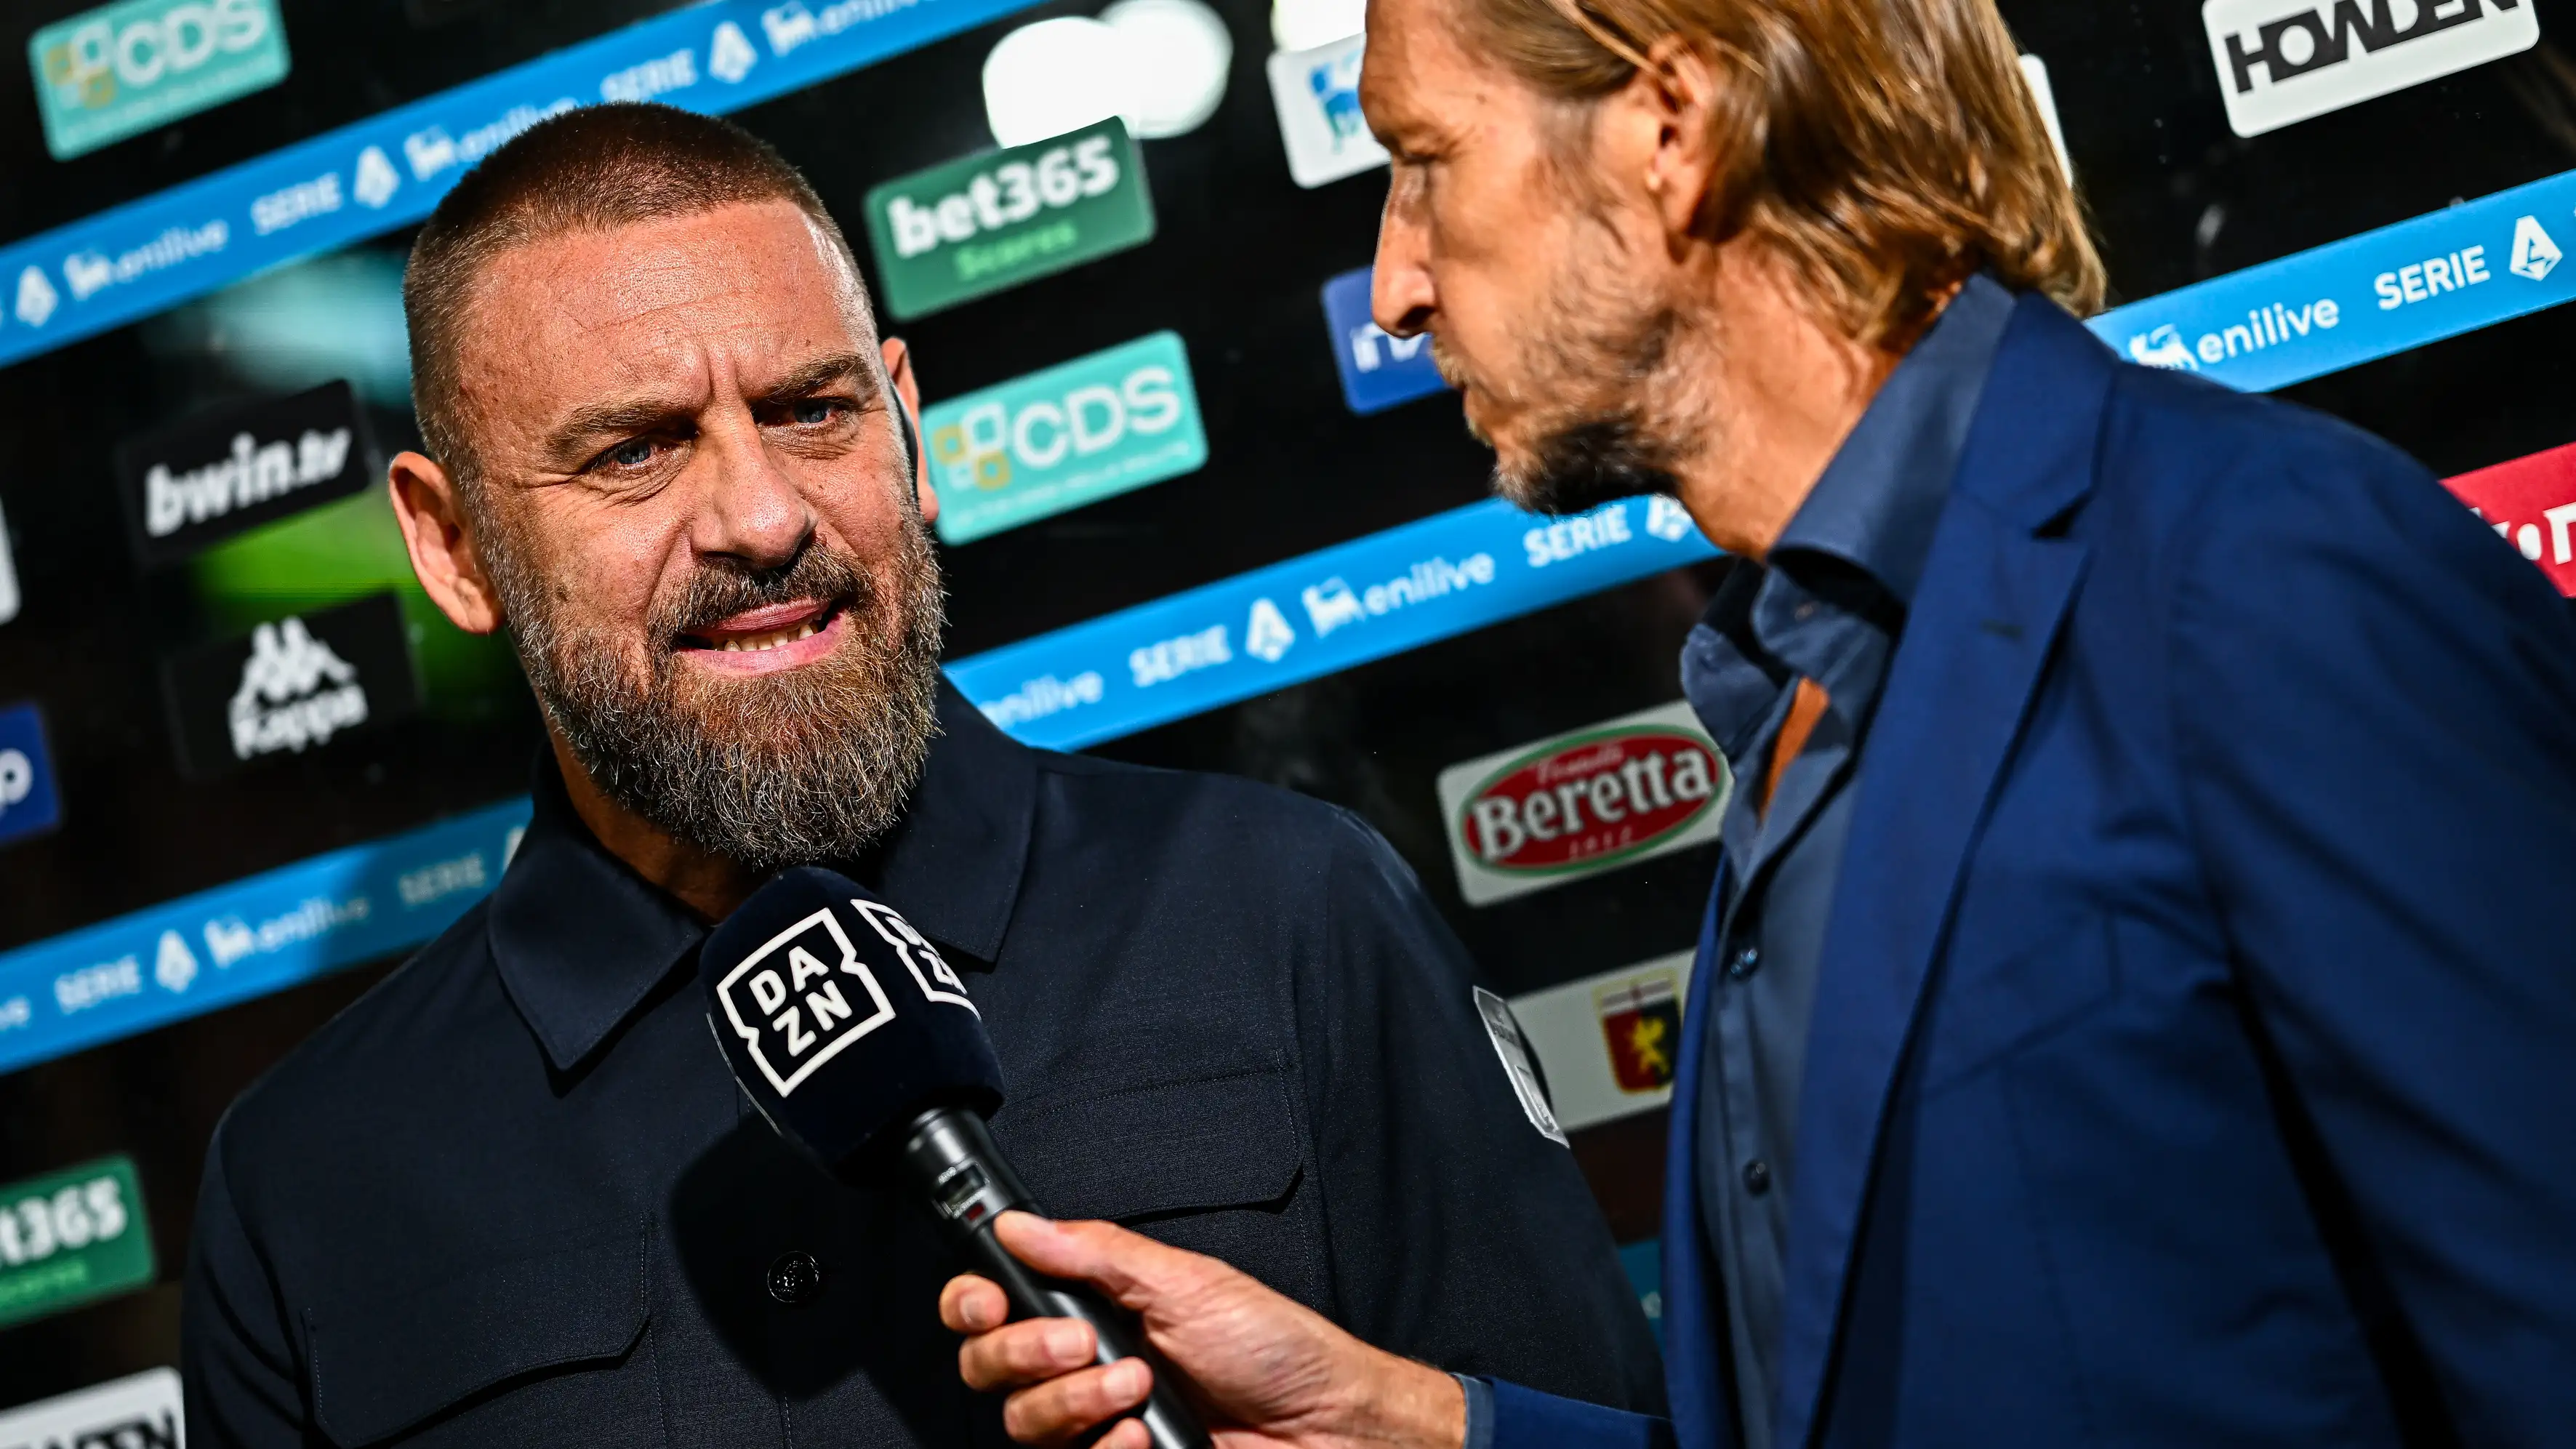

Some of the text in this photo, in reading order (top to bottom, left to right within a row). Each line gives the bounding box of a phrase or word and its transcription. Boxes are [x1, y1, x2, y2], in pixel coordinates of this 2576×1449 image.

[115, 0, 268, 86] CDS
[886, 135, 1120, 257] bet365
[2197, 298, 2340, 365] enilive
[2374, 245, 2492, 310] SERIE
[1012, 366, 1181, 468] CDS
[1128, 623, 1233, 688] SERIE
[1363, 552, 1496, 616] enilive
[1523, 502, 1632, 568] SERIE
[1472, 748, 1714, 863] Beretta
[0, 1176, 129, 1267] t365
